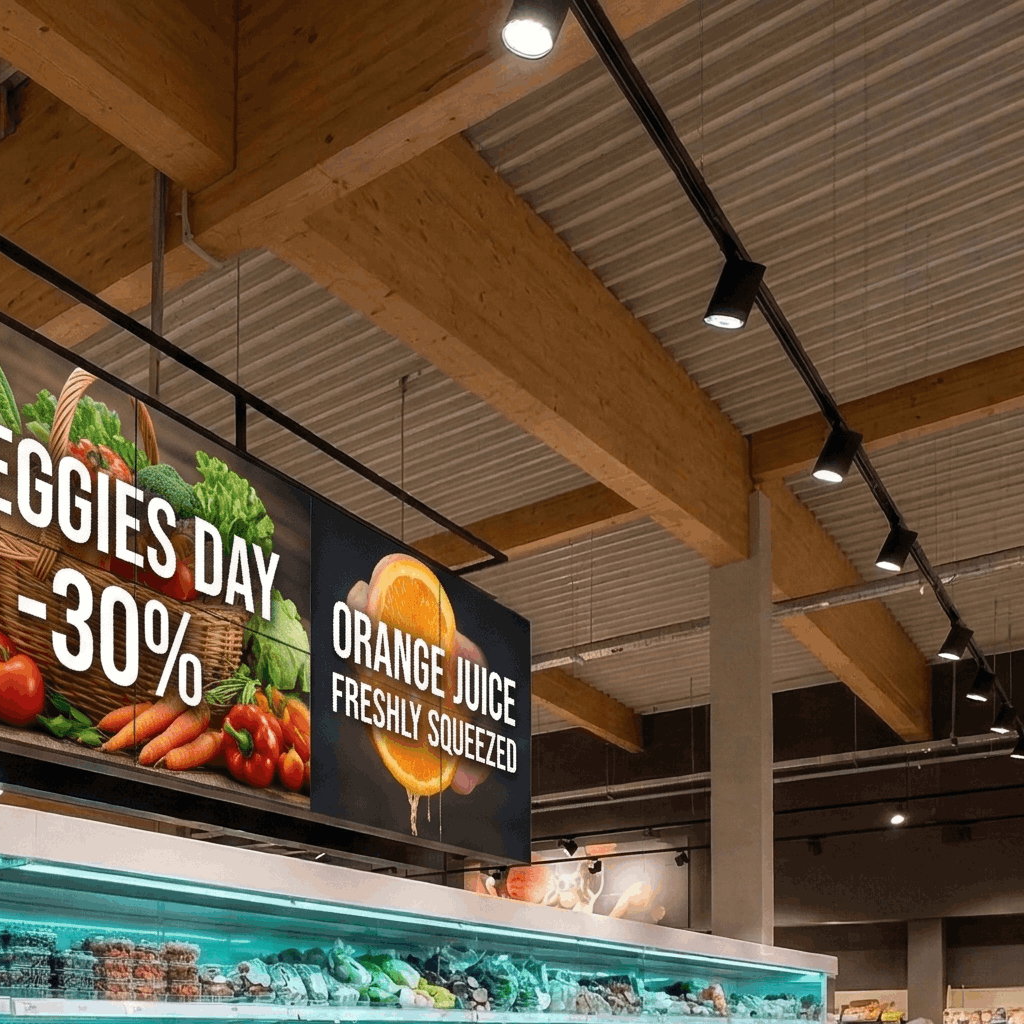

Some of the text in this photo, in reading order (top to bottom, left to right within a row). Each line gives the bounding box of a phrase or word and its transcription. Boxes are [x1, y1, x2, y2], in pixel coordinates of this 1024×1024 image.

[194, 515, 280, 621] DAY
[18, 567, 202, 707] -30%
[332, 600, 516, 728] ORANGE JUICE
[332, 671, 517, 774] FRESHLY SQUEEZED
